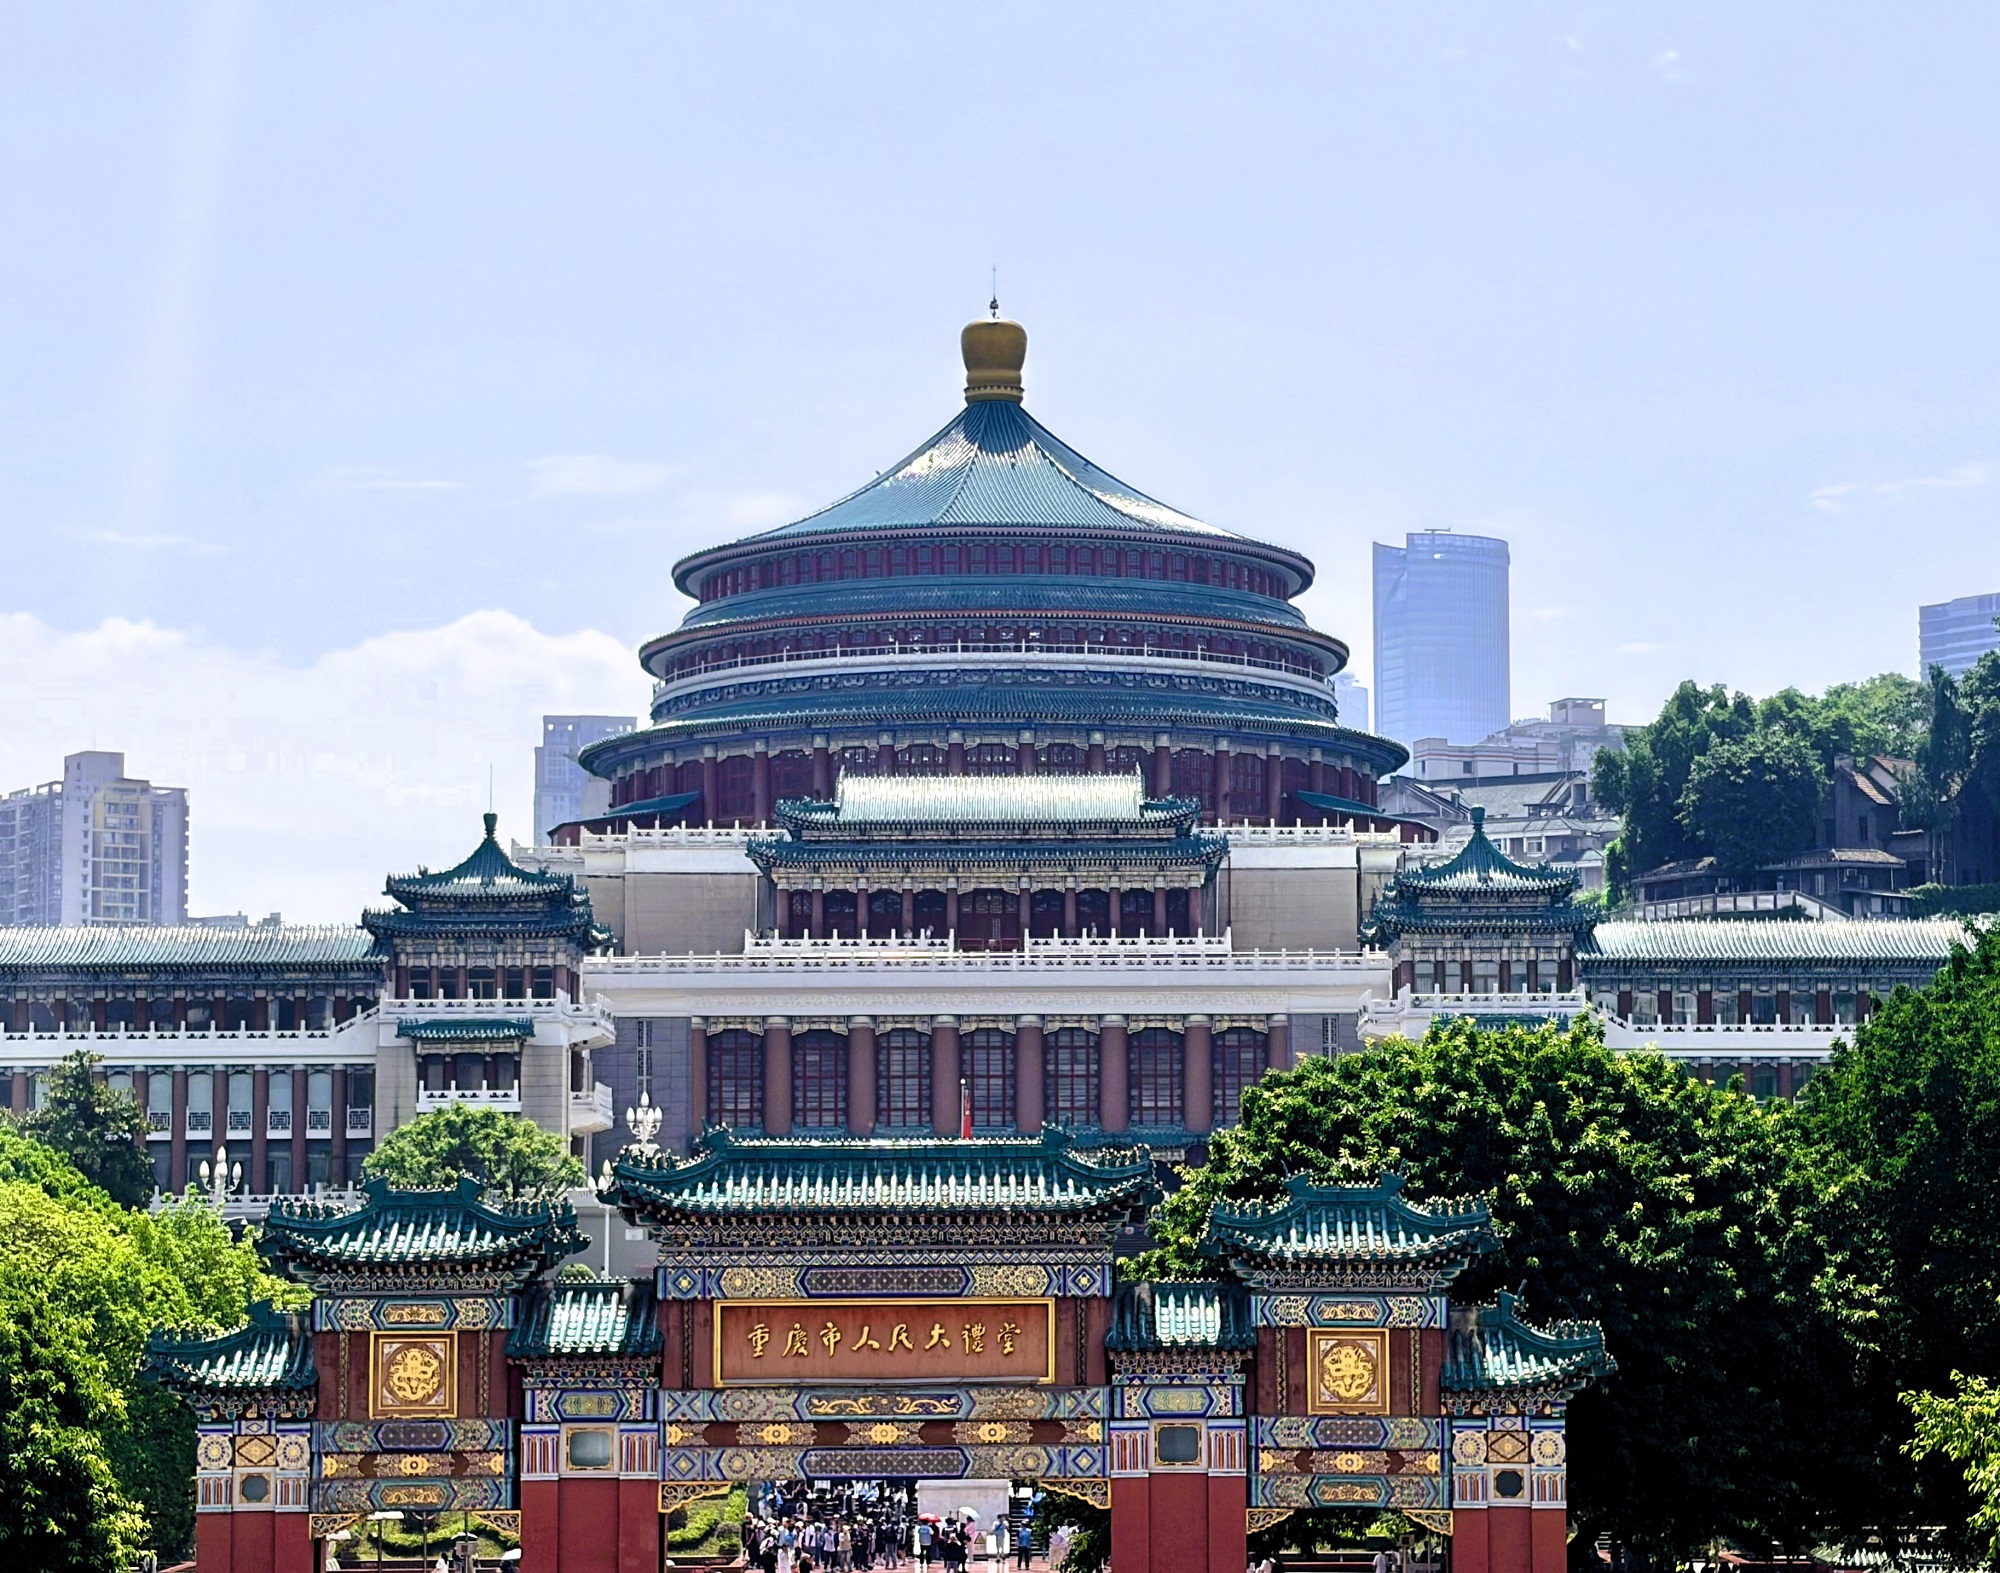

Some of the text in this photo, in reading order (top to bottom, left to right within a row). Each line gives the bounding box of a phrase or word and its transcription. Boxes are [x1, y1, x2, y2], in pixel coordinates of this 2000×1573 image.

[747, 1321, 1022, 1358] 重慶市人民大禮堂
